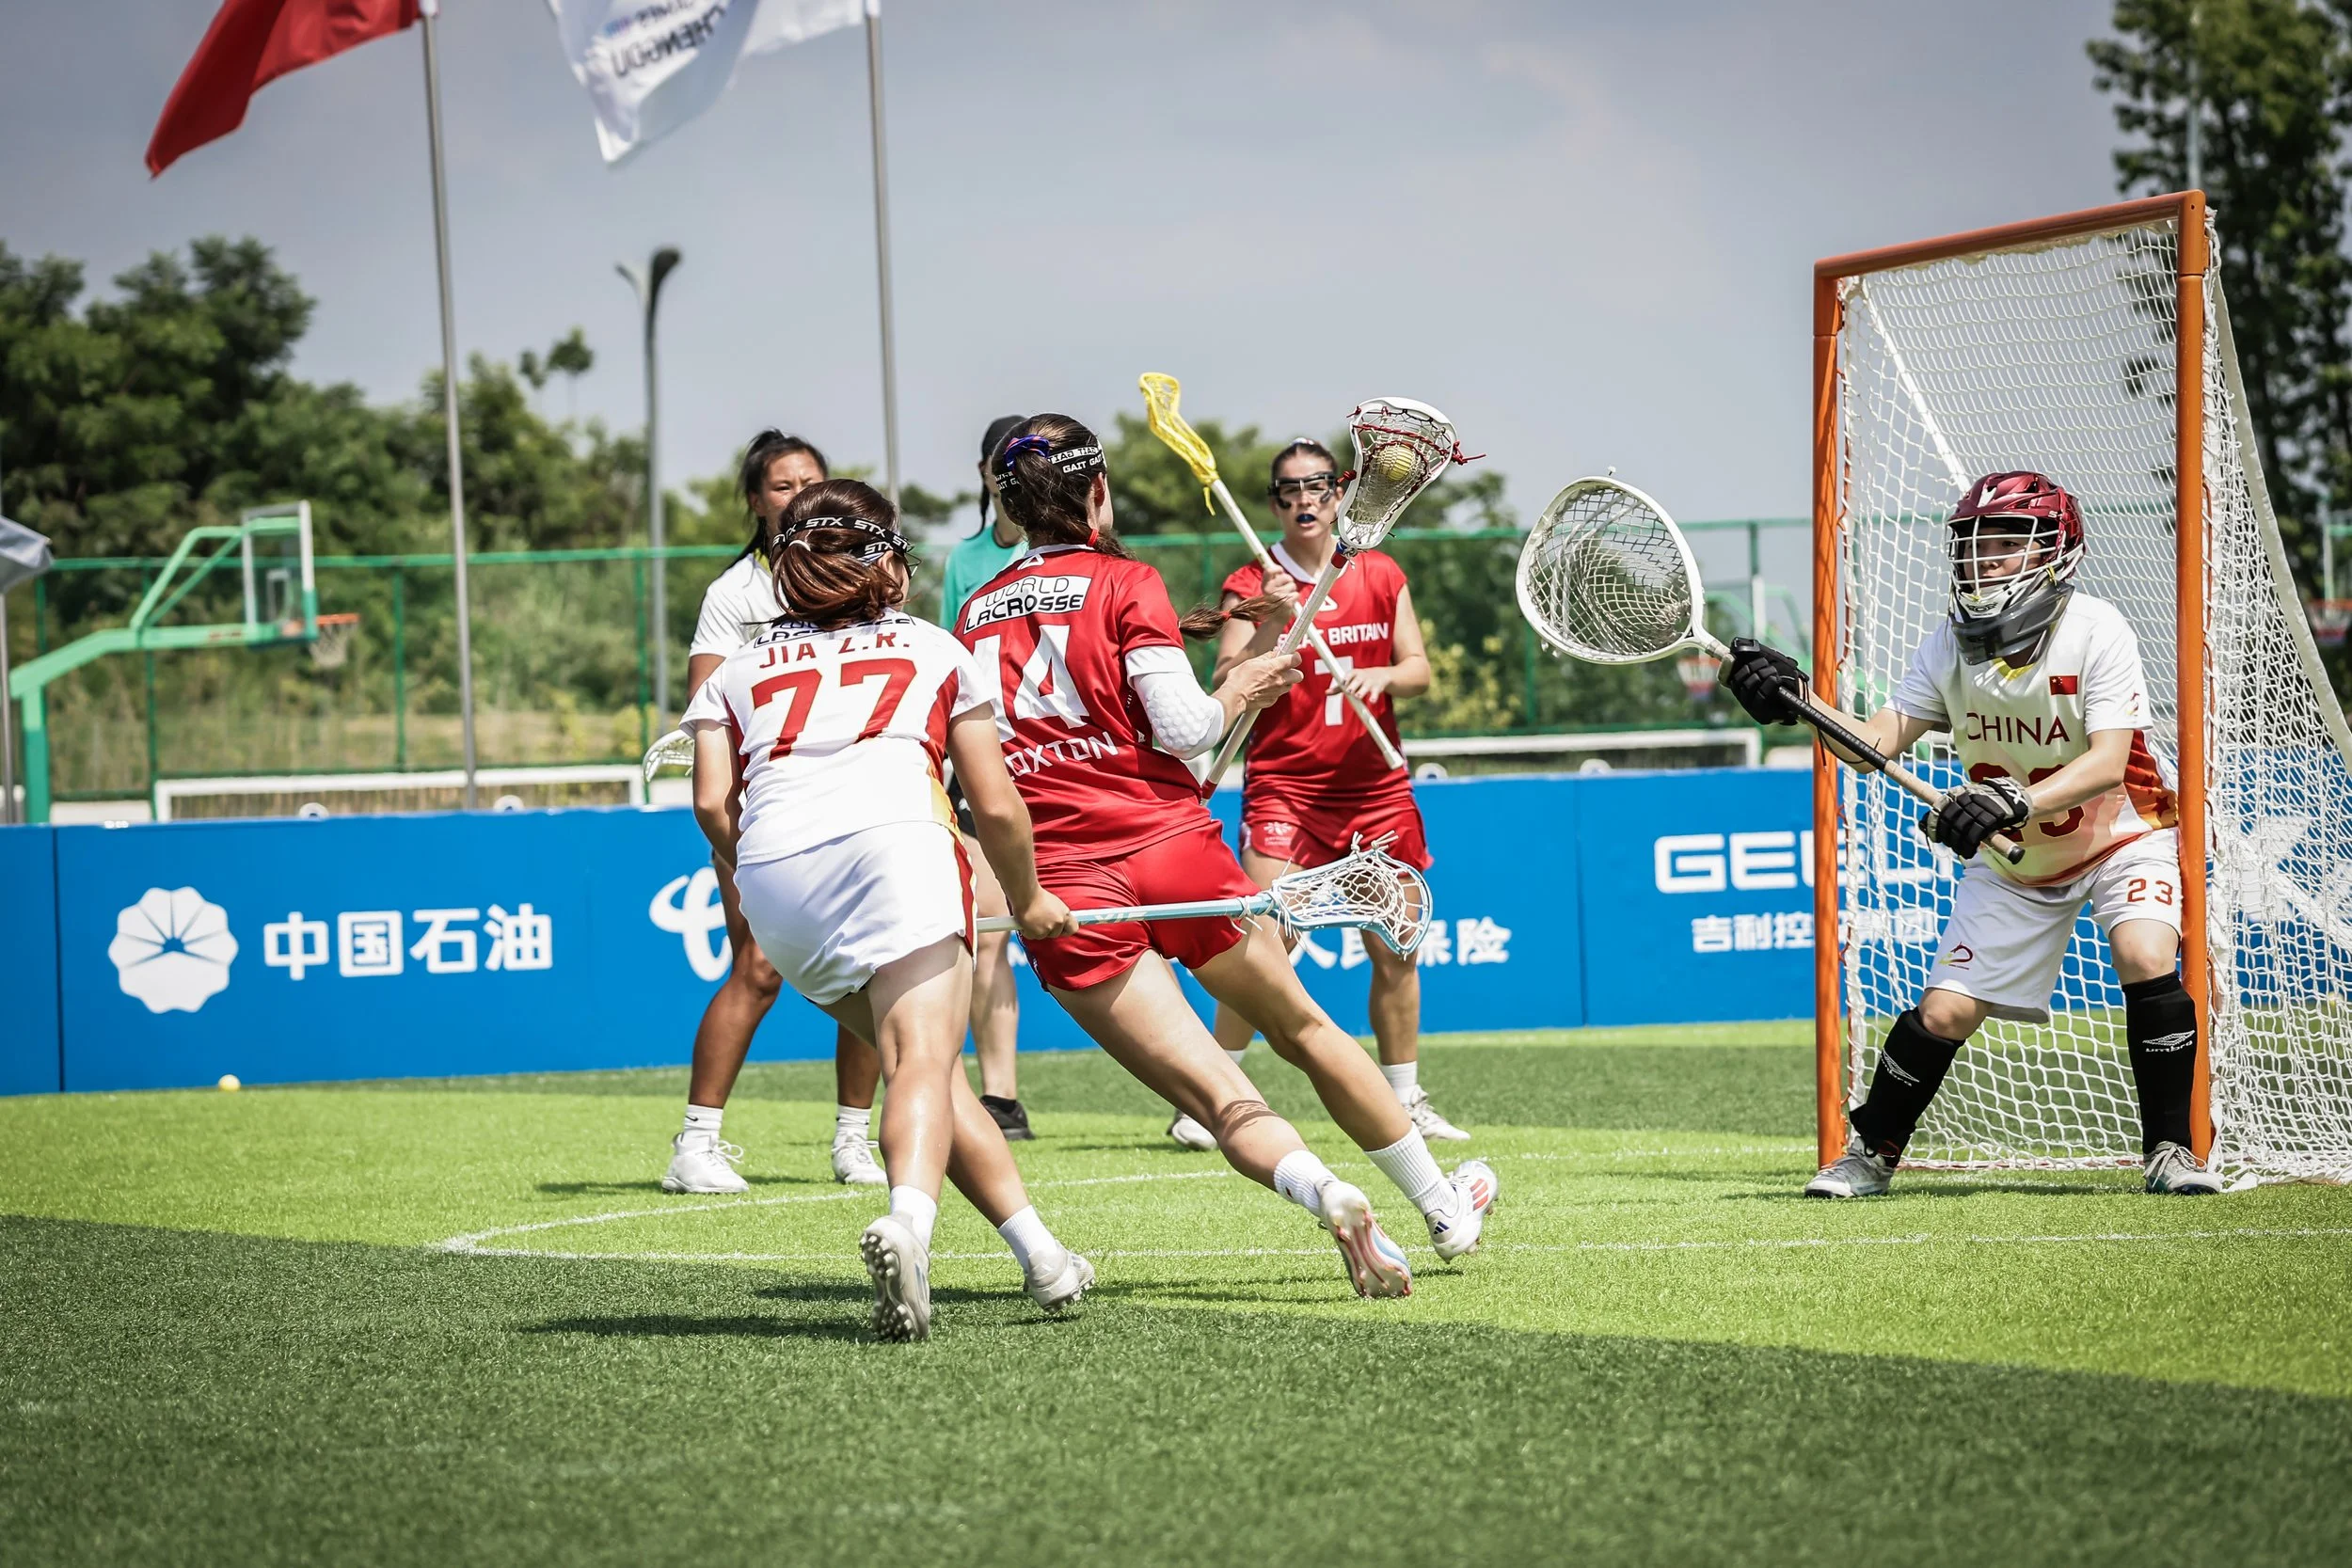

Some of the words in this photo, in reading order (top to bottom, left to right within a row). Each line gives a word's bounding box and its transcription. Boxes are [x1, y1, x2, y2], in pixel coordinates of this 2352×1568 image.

[1062, 460, 1087, 473] GAIT
[805, 516, 844, 529] STX
[853, 519, 886, 538] STX
[865, 540, 895, 555] STX
[985, 577, 1070, 607] WORLD
[965, 594, 1084, 631] LACROSSE
[1327, 622, 1390, 646] BRITAIN
[759, 642, 817, 669] JIA
[973, 624, 1090, 743] 14
[1313, 656, 1355, 727] 7
[751, 657, 917, 761] 77
[1965, 712, 2071, 747] CHINA
[1004, 731, 1120, 782] OXTON
[2127, 878, 2173, 906] 23
[262, 903, 553, 982] 中国石油
